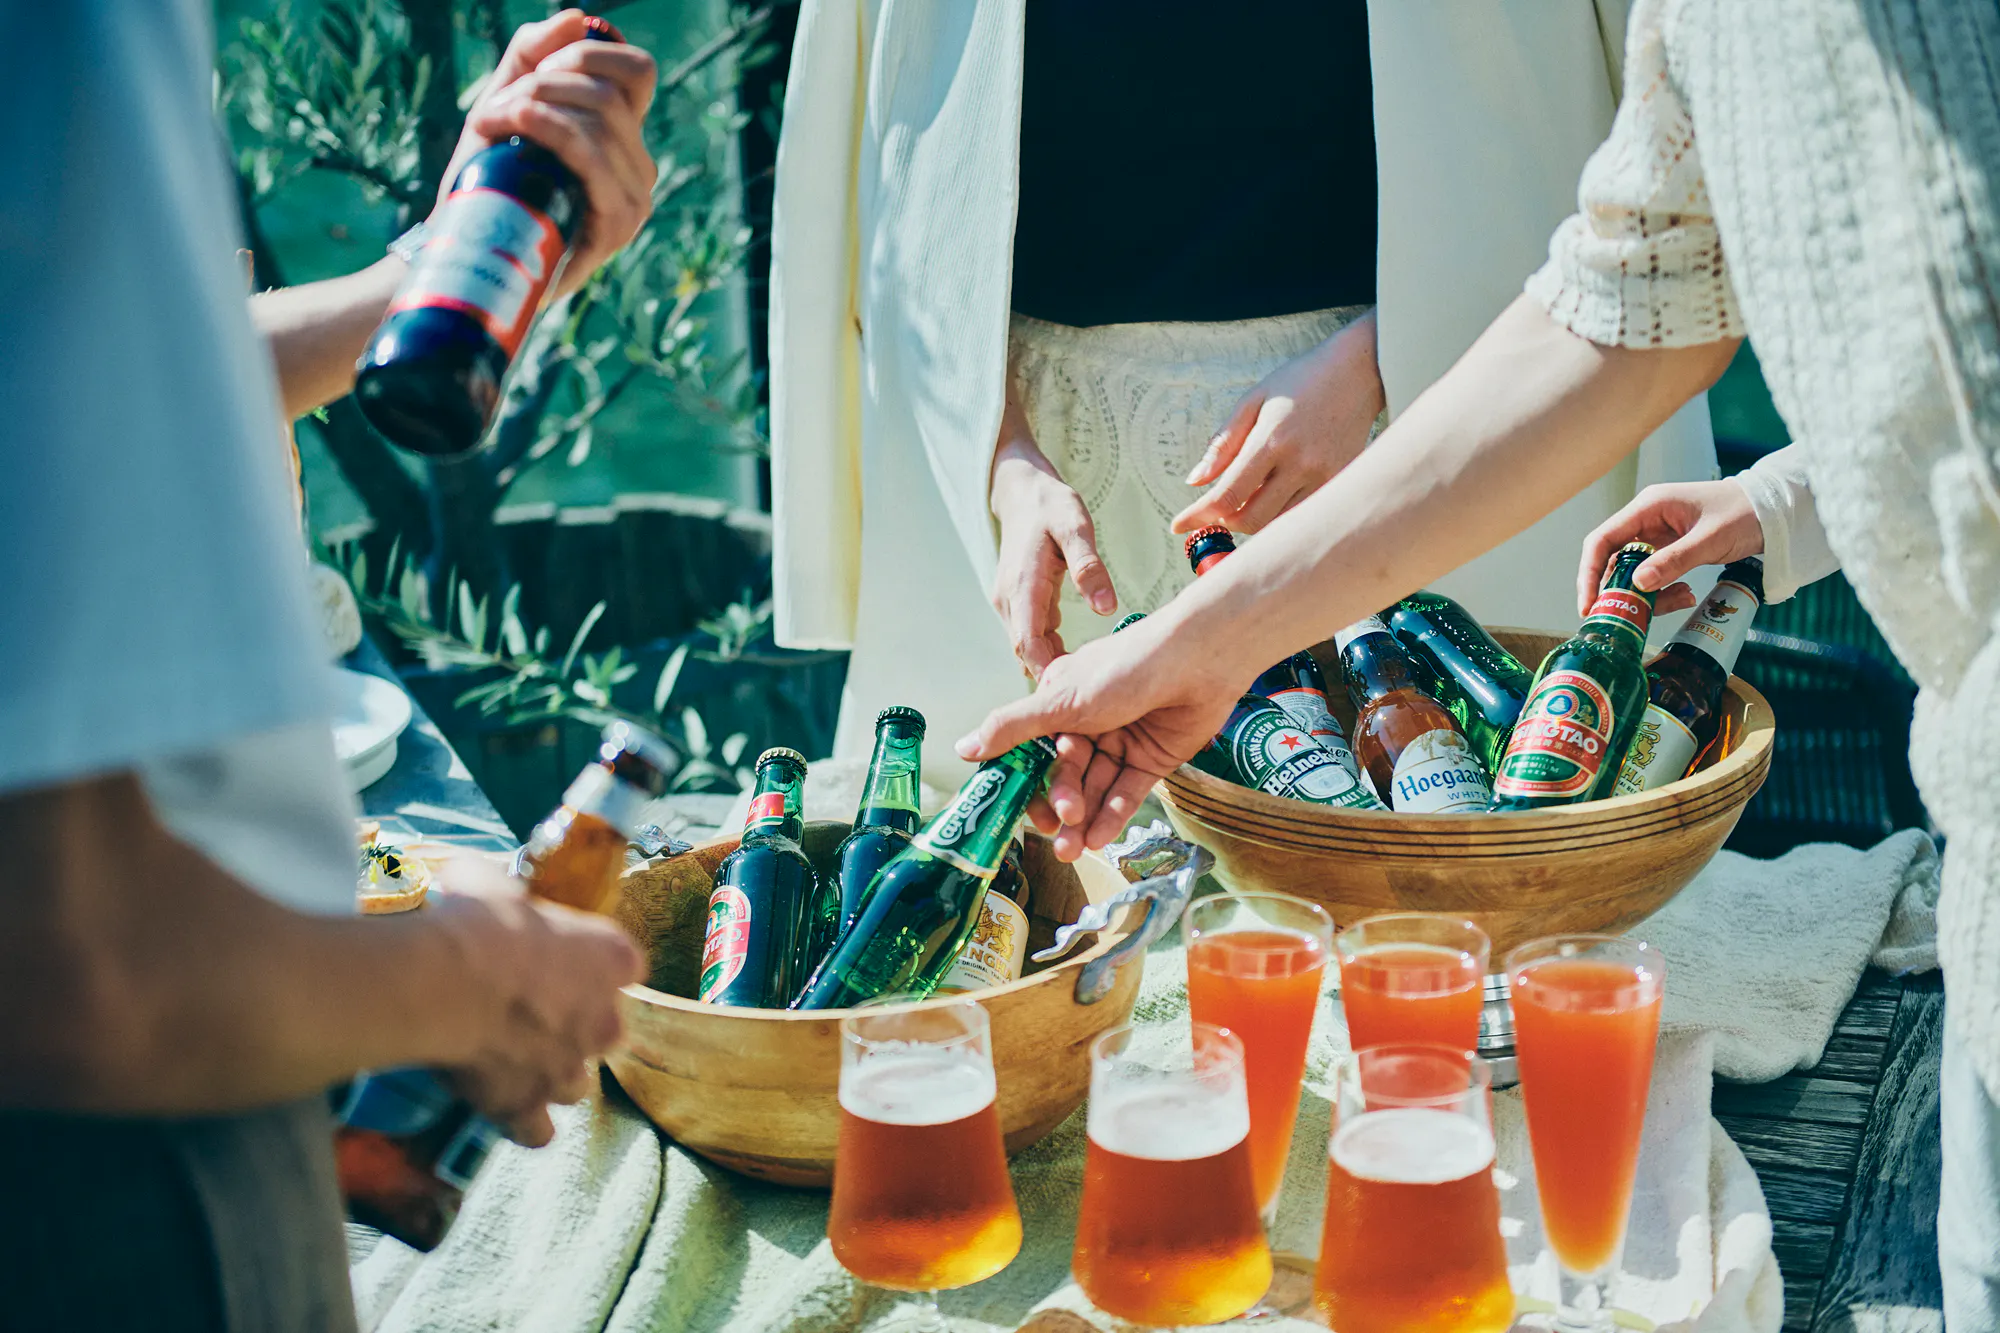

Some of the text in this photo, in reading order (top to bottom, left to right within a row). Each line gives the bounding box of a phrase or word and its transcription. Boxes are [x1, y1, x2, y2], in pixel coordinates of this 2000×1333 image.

[1250, 721, 1276, 771] HEINEKEN
[1262, 749, 1338, 797] Heinek
[1397, 768, 1487, 801] Hoegaar
[931, 767, 1006, 846] Carlsberg
[1331, 791, 1361, 808] MALT
[962, 946, 1013, 981] INGHA
